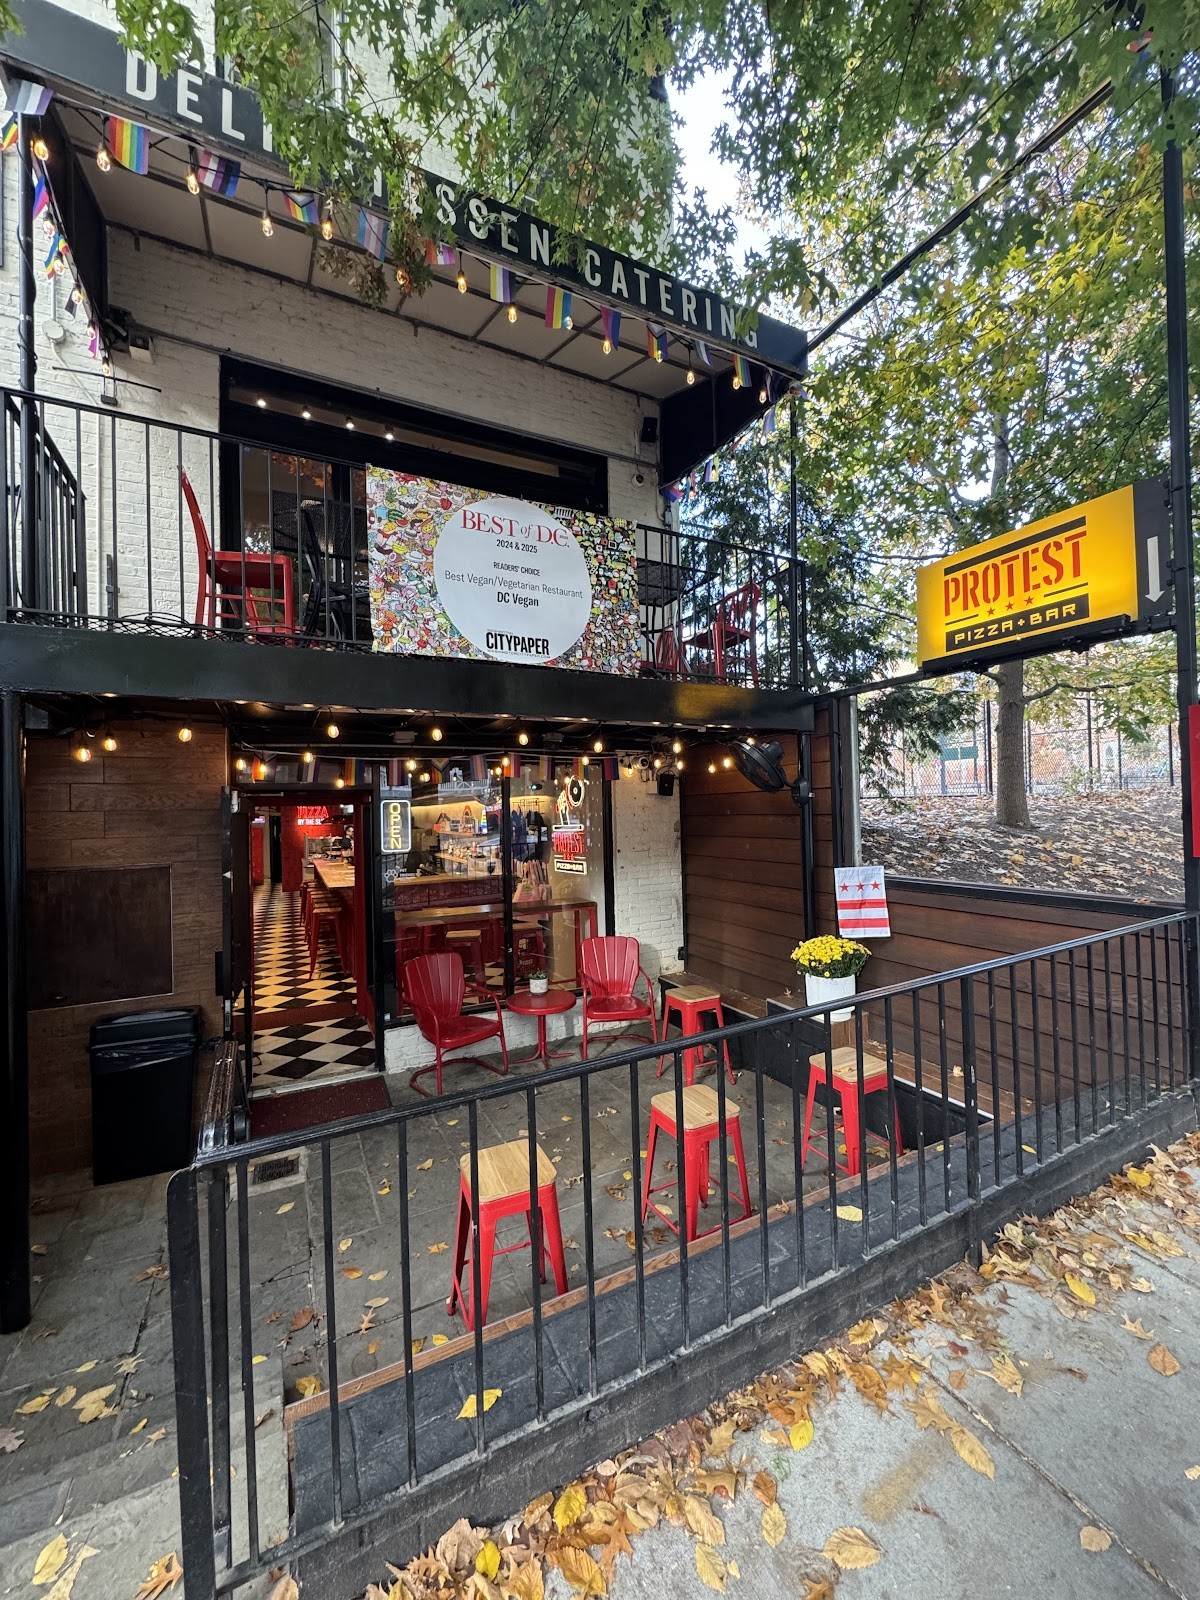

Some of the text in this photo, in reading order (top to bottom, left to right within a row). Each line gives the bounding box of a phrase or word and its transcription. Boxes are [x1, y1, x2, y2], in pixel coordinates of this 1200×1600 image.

[584, 248, 758, 348] CATERING
[460, 508, 570, 548] BEST of D.C.
[496, 538, 538, 553] 2024 & 2025
[493, 561, 541, 577] READERS' CHOICE
[944, 530, 1087, 617] PROTEST
[444, 570, 583, 599] Best Vegan/Vegetarian Restaurant
[497, 591, 539, 608] DC Vegan
[486, 632, 550, 655] CITYPAPER
[297, 805, 329, 819] PIZZA
[389, 802, 402, 849] OPEN
